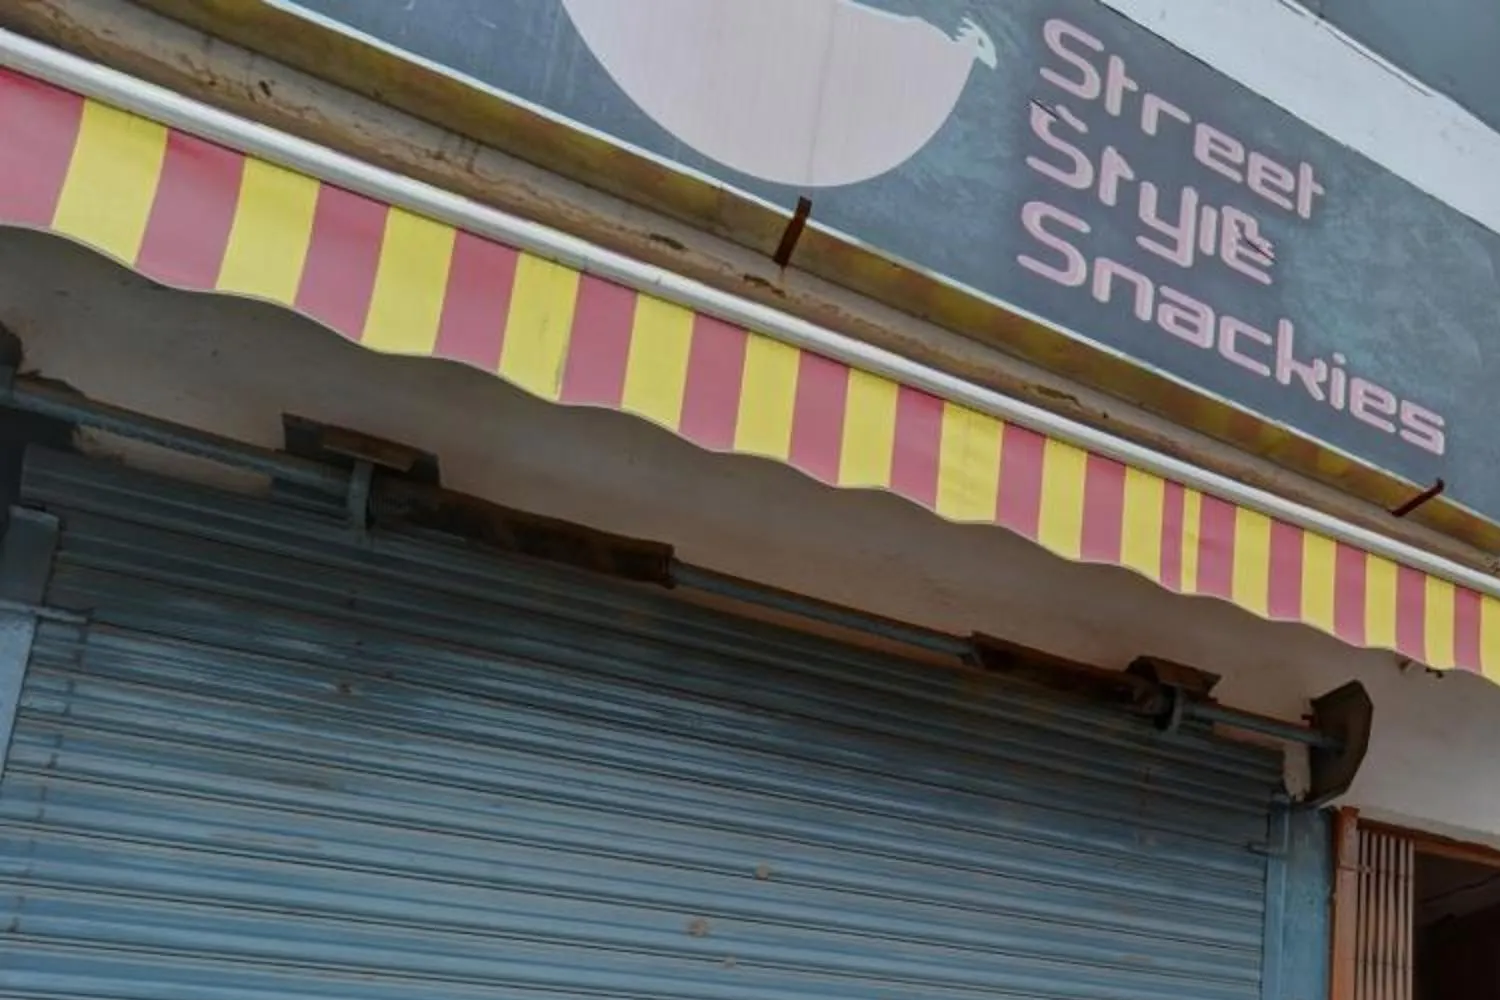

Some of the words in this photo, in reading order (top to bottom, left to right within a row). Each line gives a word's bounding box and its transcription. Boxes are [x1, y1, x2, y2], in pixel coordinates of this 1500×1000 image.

[1026, 101, 1275, 284] Style
[1040, 19, 1325, 219] Street
[1017, 201, 1445, 455] Snackies
